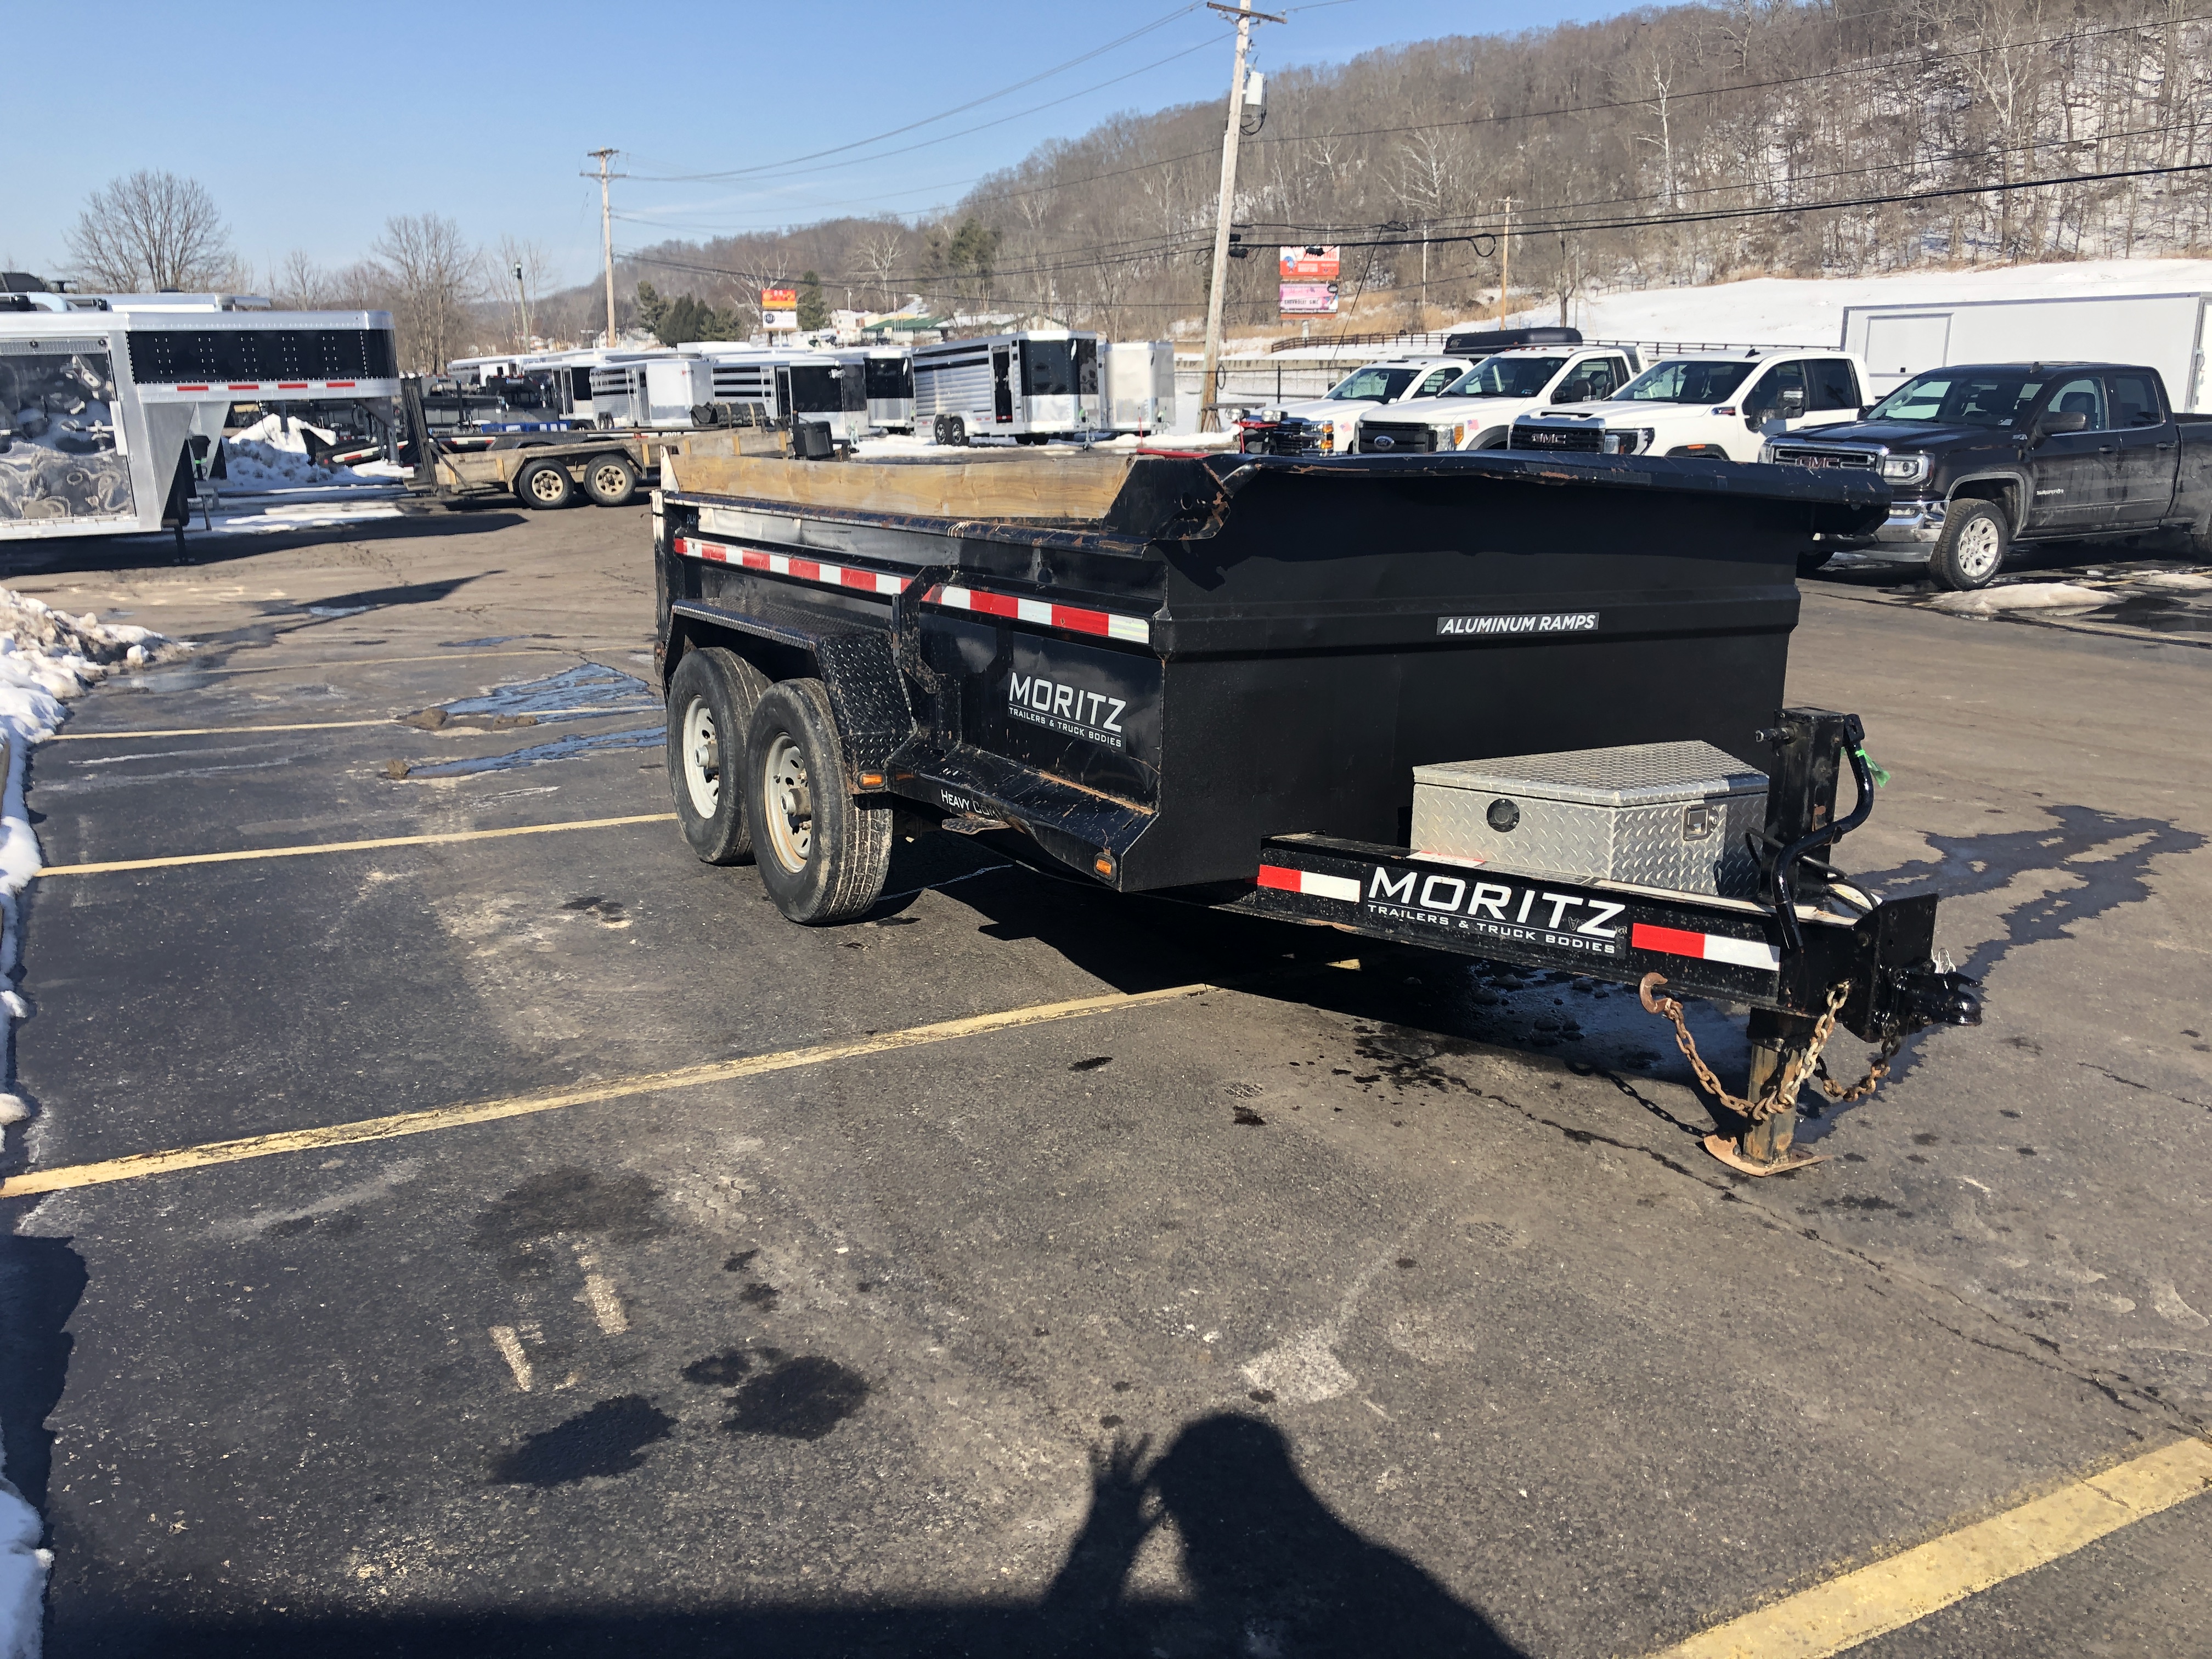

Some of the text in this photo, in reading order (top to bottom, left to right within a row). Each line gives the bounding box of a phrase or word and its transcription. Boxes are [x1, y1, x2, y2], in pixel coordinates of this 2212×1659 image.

[1532, 432, 1566, 444] GMC
[1795, 456, 1841, 469] GMC
[686, 514, 696, 524] DLH
[1441, 614, 1596, 634] ALUMINUM RAMPS
[1009, 672, 1126, 733] MORITZ
[1009, 707, 1121, 748] TRAILERS & TRUCK BODIES
[941, 789, 969, 811] HEAVY
[1368, 866, 1626, 938] MORITZ
[1368, 904, 1615, 954] TRAILERS & TRUCK BODIES
